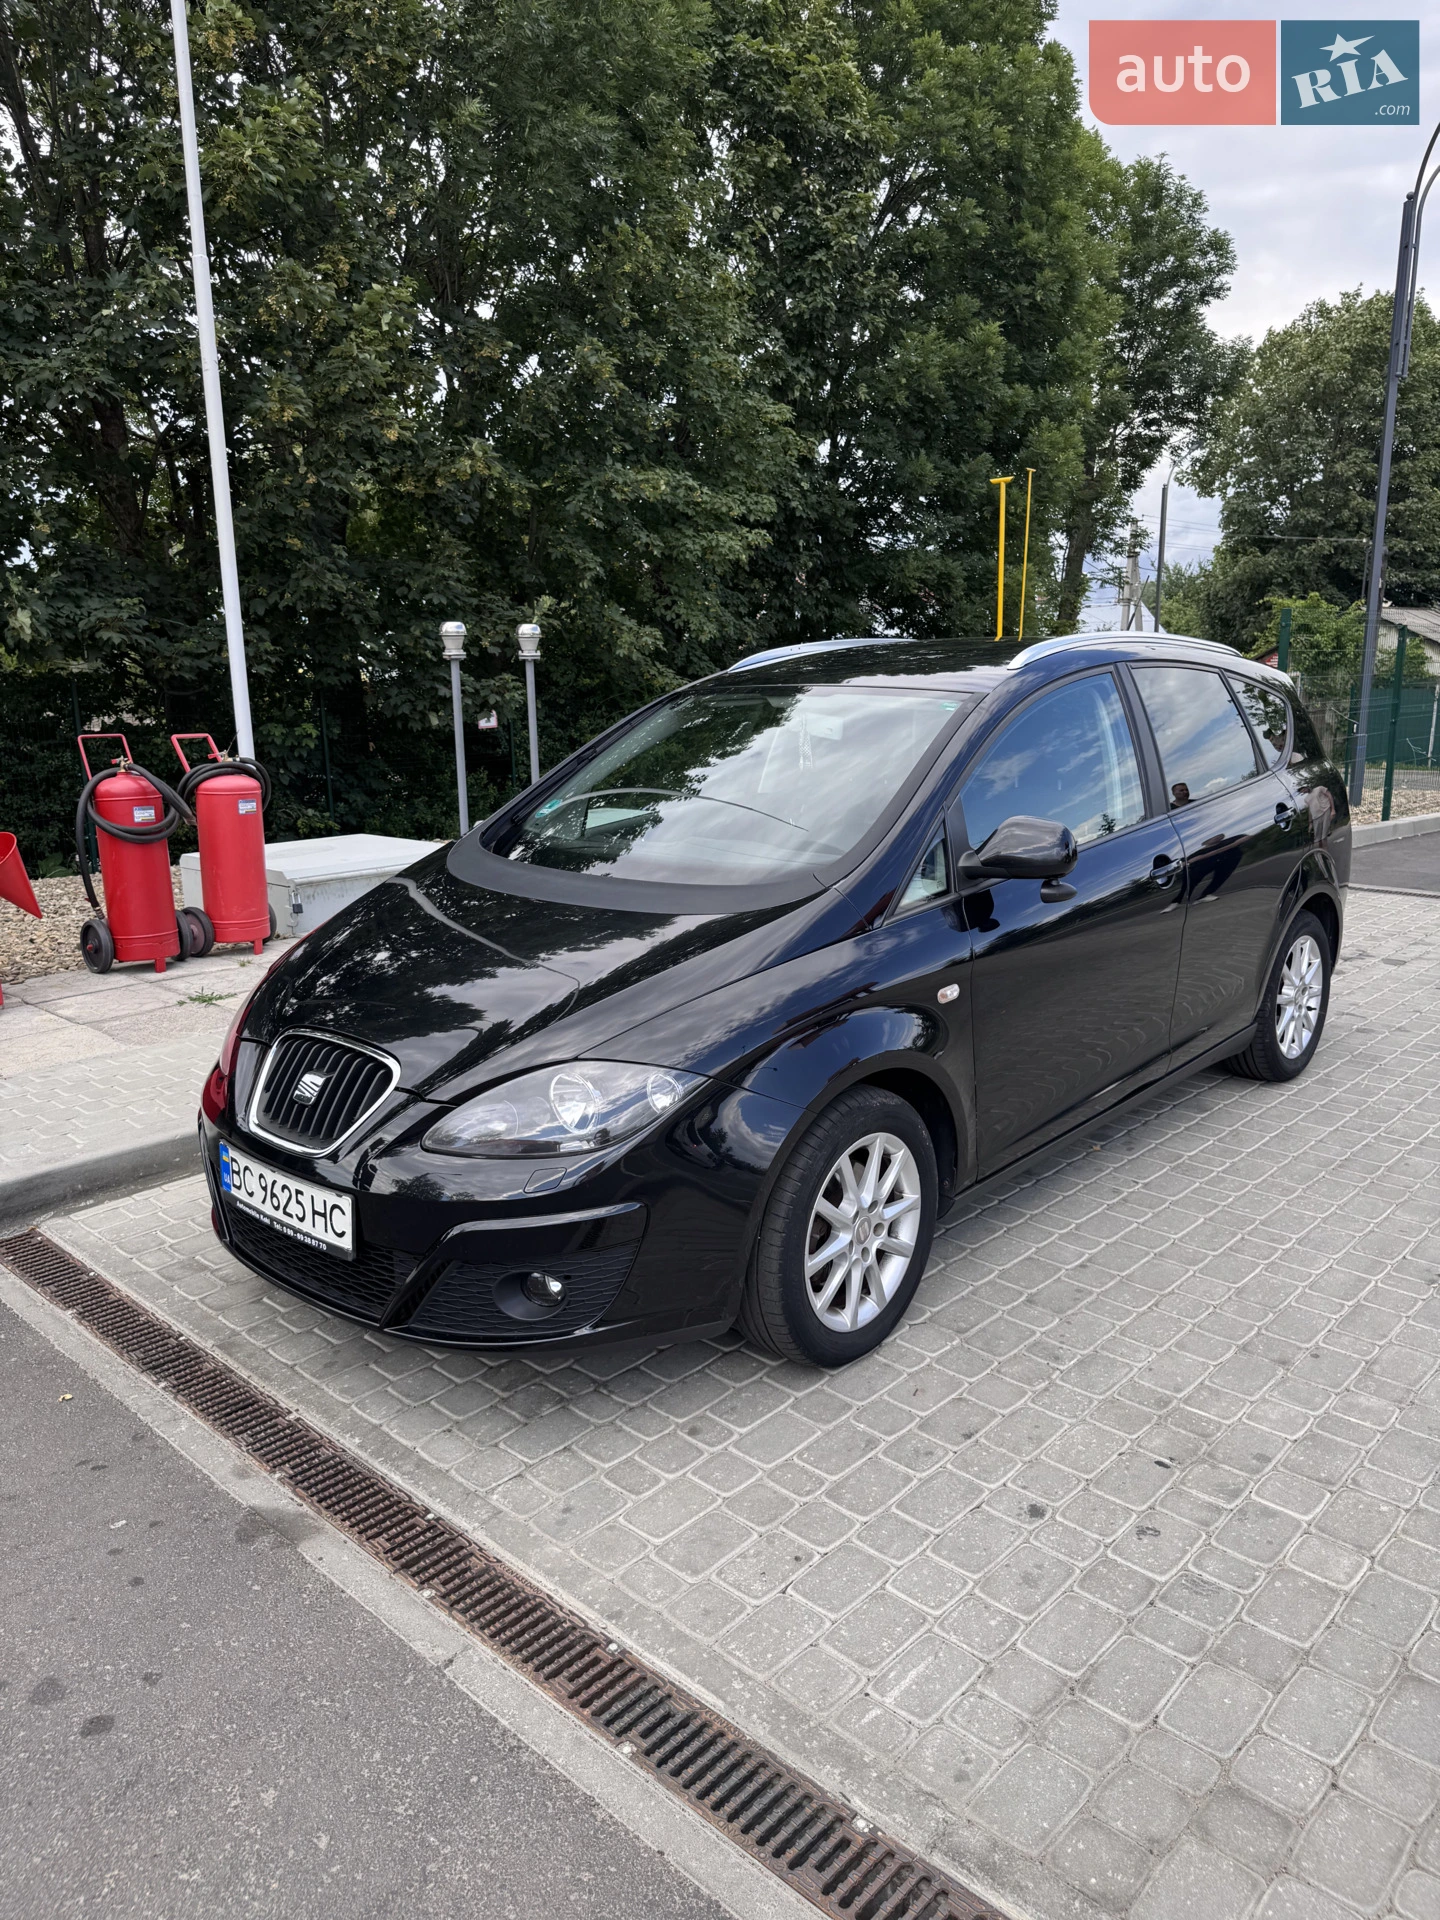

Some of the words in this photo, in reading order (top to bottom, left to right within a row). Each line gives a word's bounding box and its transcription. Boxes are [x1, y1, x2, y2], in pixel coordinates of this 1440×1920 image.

[231, 1157, 254, 1198] BC
[258, 1173, 306, 1223] 9625
[311, 1194, 346, 1238] HC
